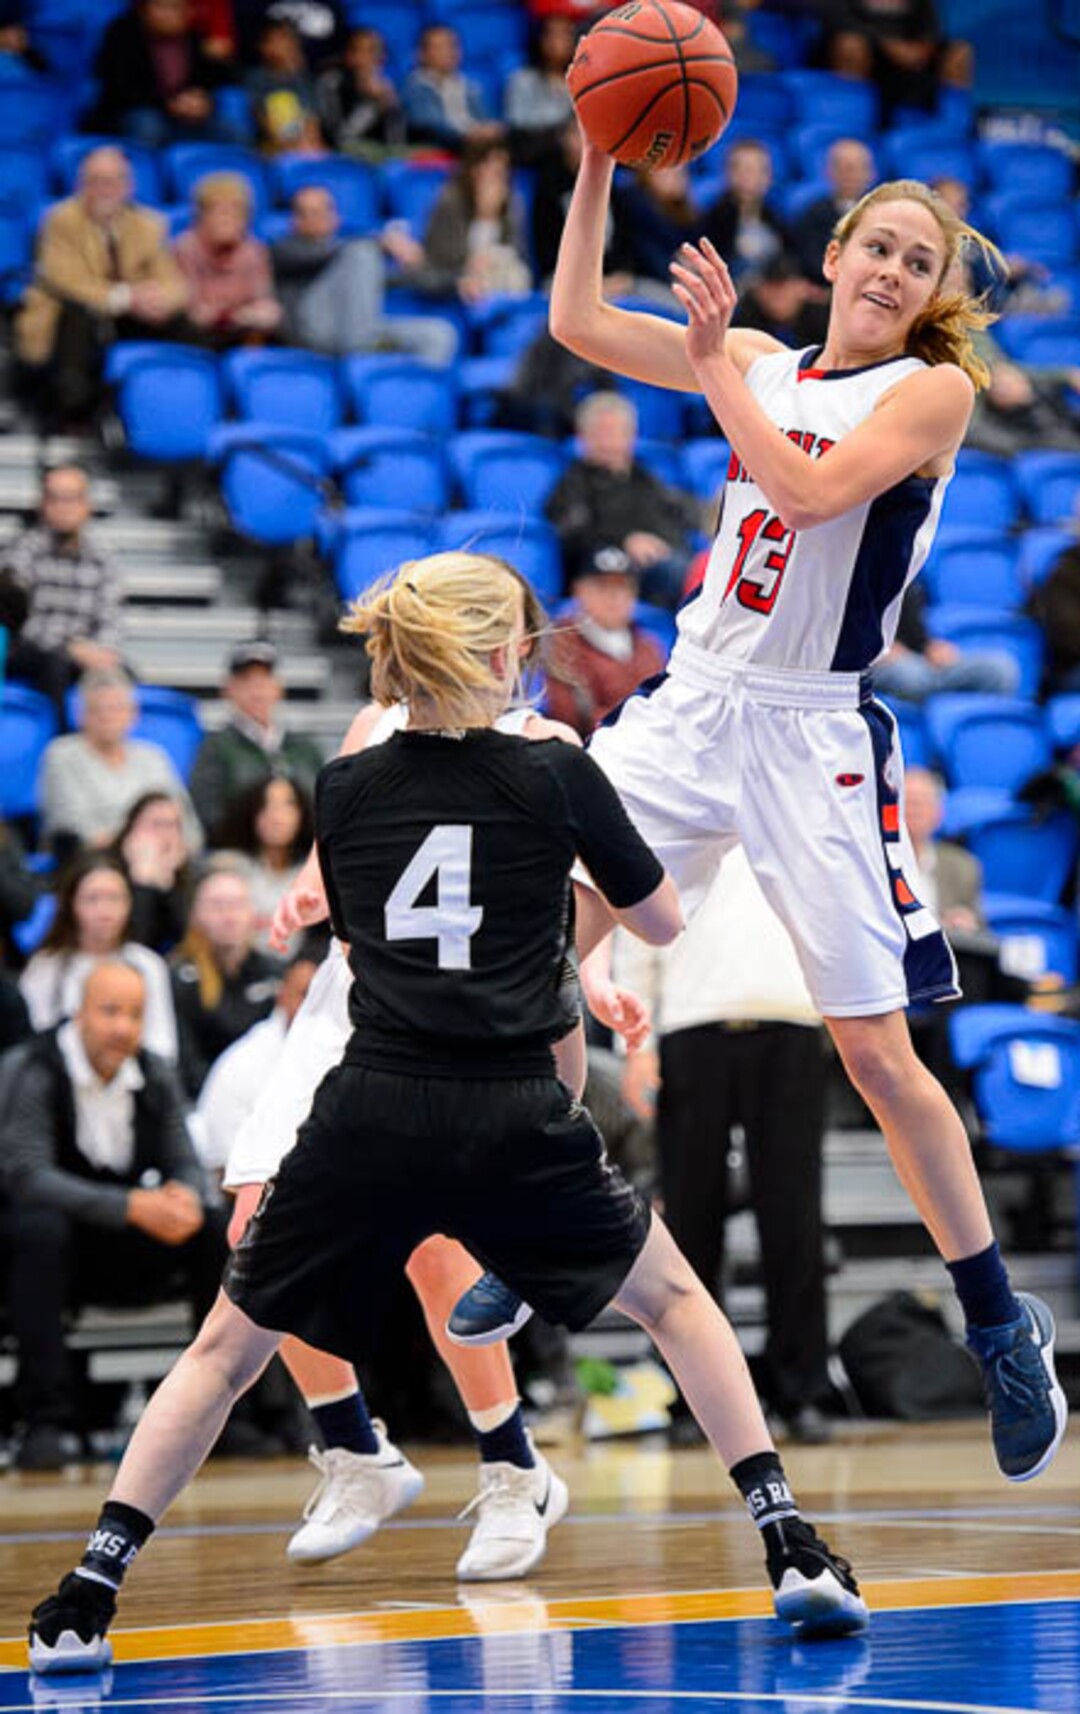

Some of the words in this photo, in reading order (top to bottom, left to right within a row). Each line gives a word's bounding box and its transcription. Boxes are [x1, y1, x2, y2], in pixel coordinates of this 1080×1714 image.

[720, 509, 796, 614] 13
[384, 824, 484, 970] 4
[87, 1530, 126, 1556] MS
